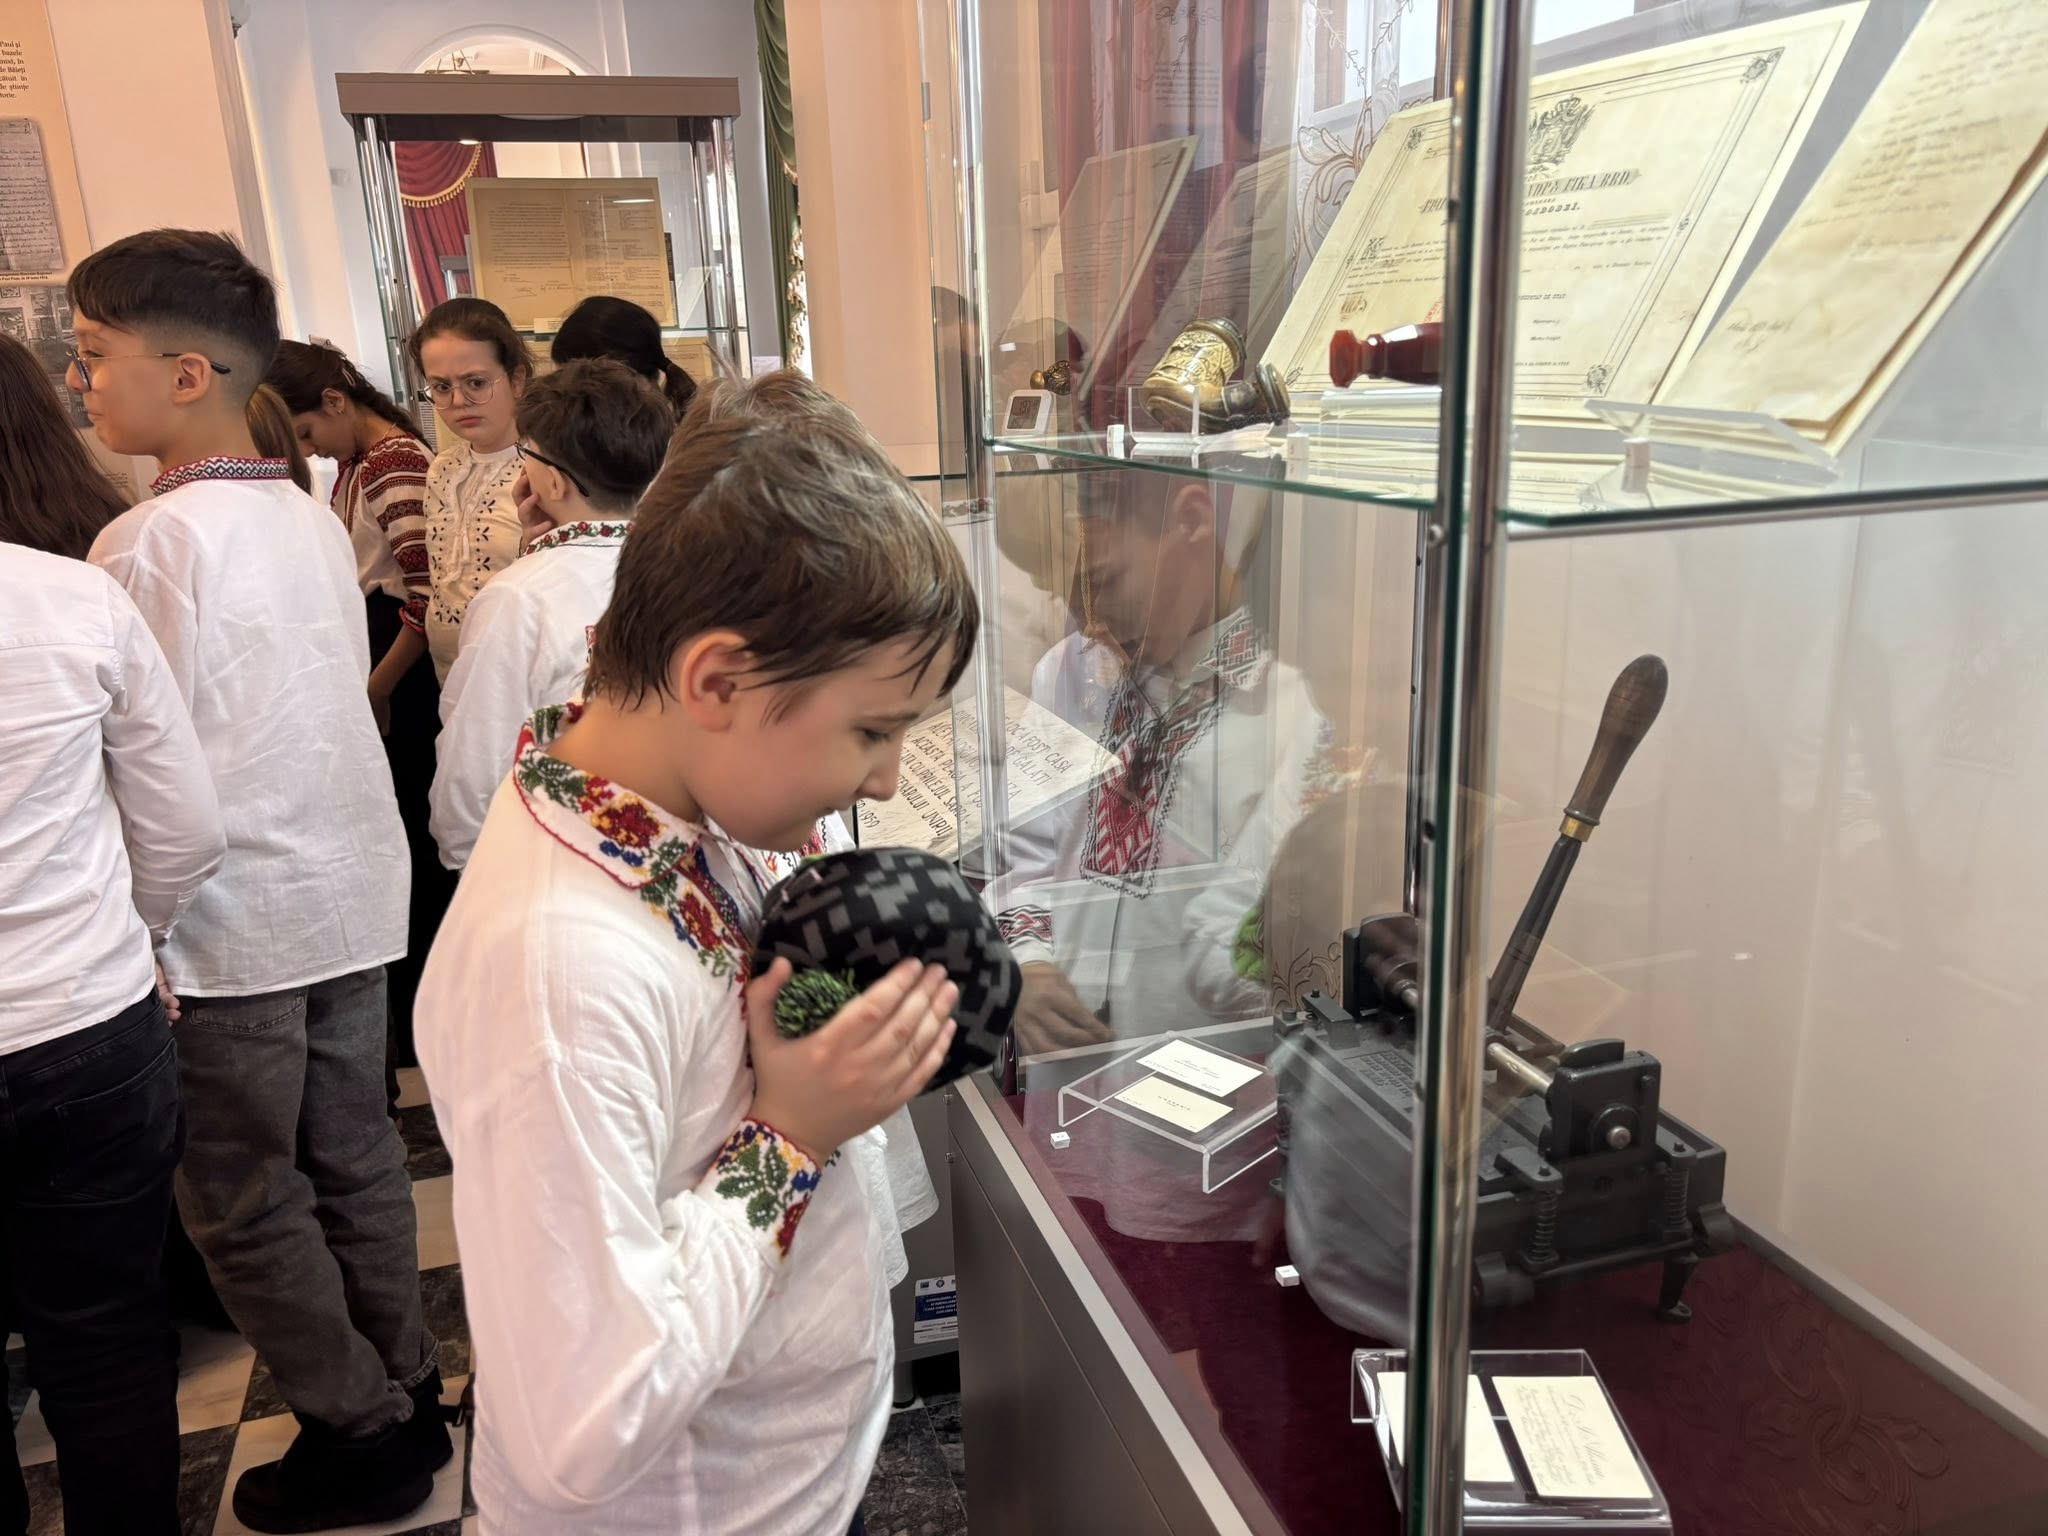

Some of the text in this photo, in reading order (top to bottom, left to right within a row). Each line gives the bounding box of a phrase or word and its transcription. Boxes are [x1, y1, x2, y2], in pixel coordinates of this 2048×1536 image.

[1022, 735, 1051, 754] FOST
[1045, 752, 1073, 774] CASA
[912, 736, 945, 762] ACEASTA
[967, 789, 983, 808] FOS
[915, 768, 951, 800] PRILEJUL
[858, 808, 881, 828] 1959
[921, 809, 953, 837] UNIRII
